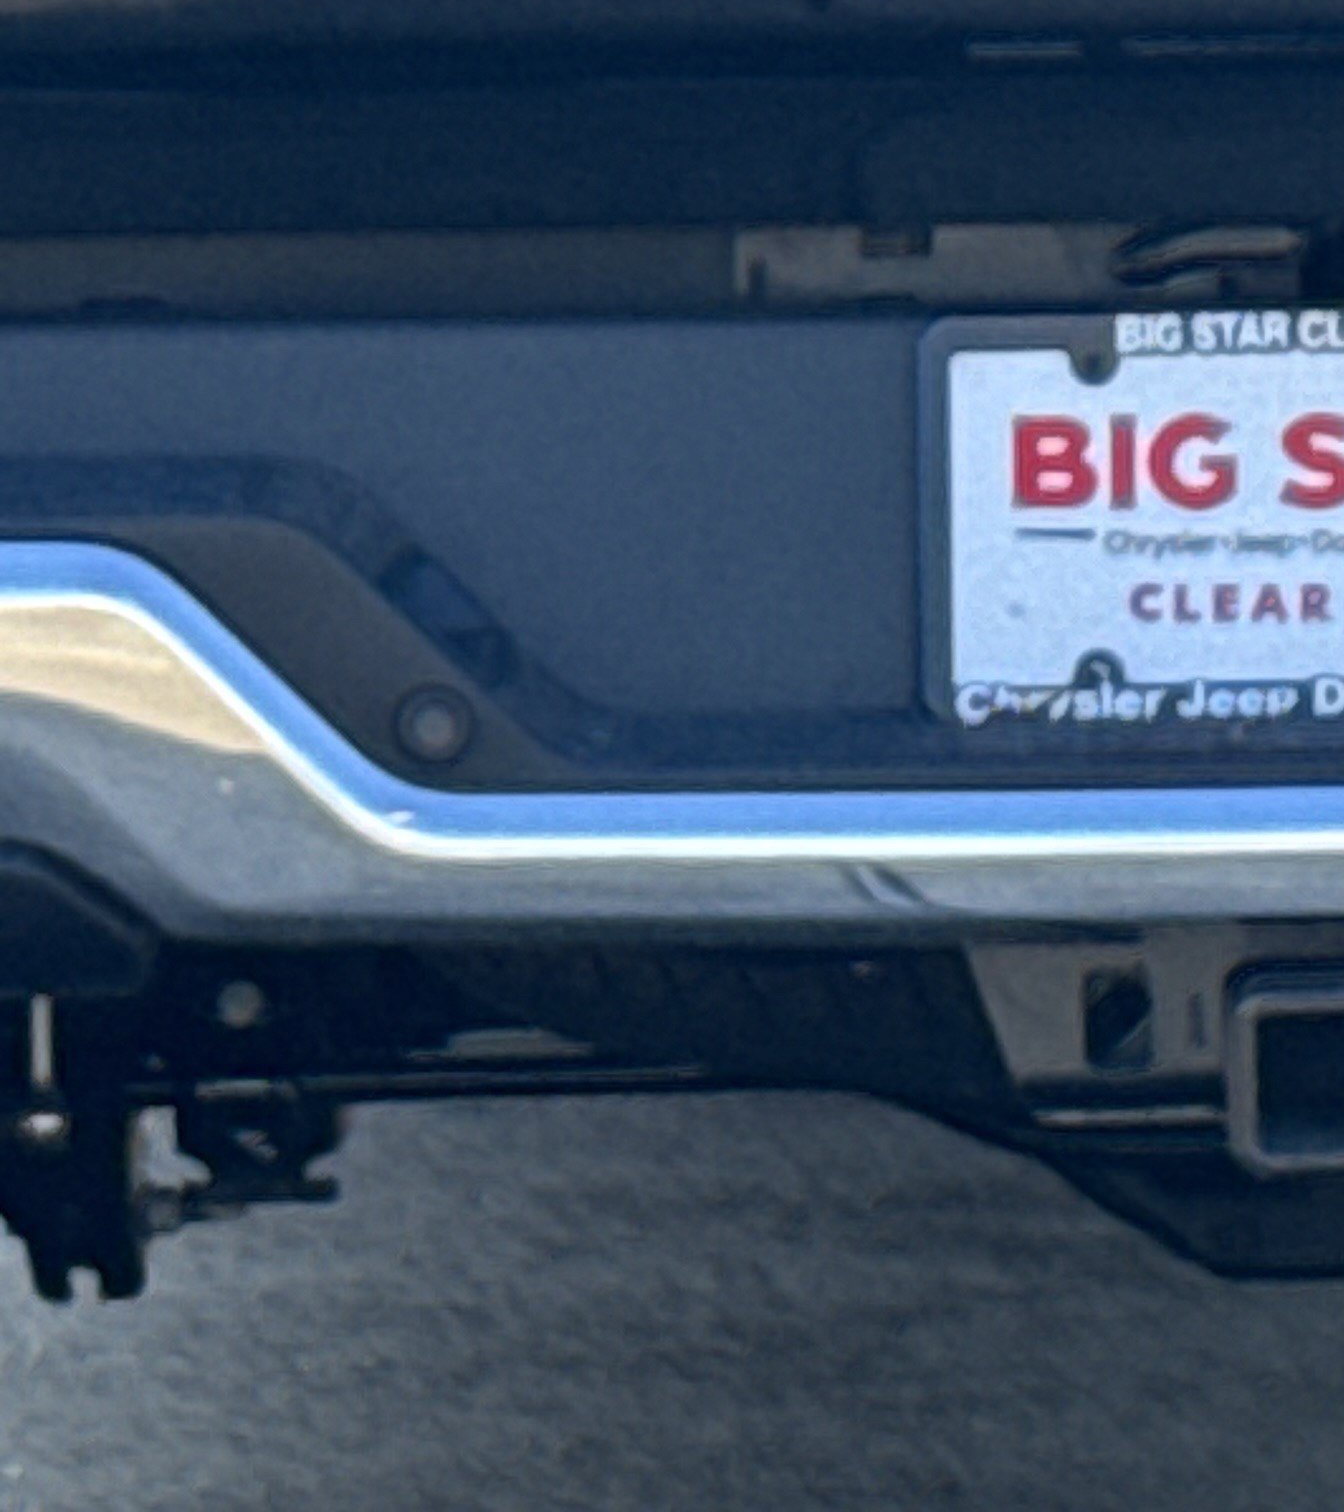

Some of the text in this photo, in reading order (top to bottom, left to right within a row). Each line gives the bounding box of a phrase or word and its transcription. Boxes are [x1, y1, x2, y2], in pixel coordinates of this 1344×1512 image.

[1114, 311, 1183, 354] BIG
[1191, 309, 1292, 352] STAR
[1010, 411, 1239, 510] BIG
[1127, 581, 1333, 623] CLEAR
